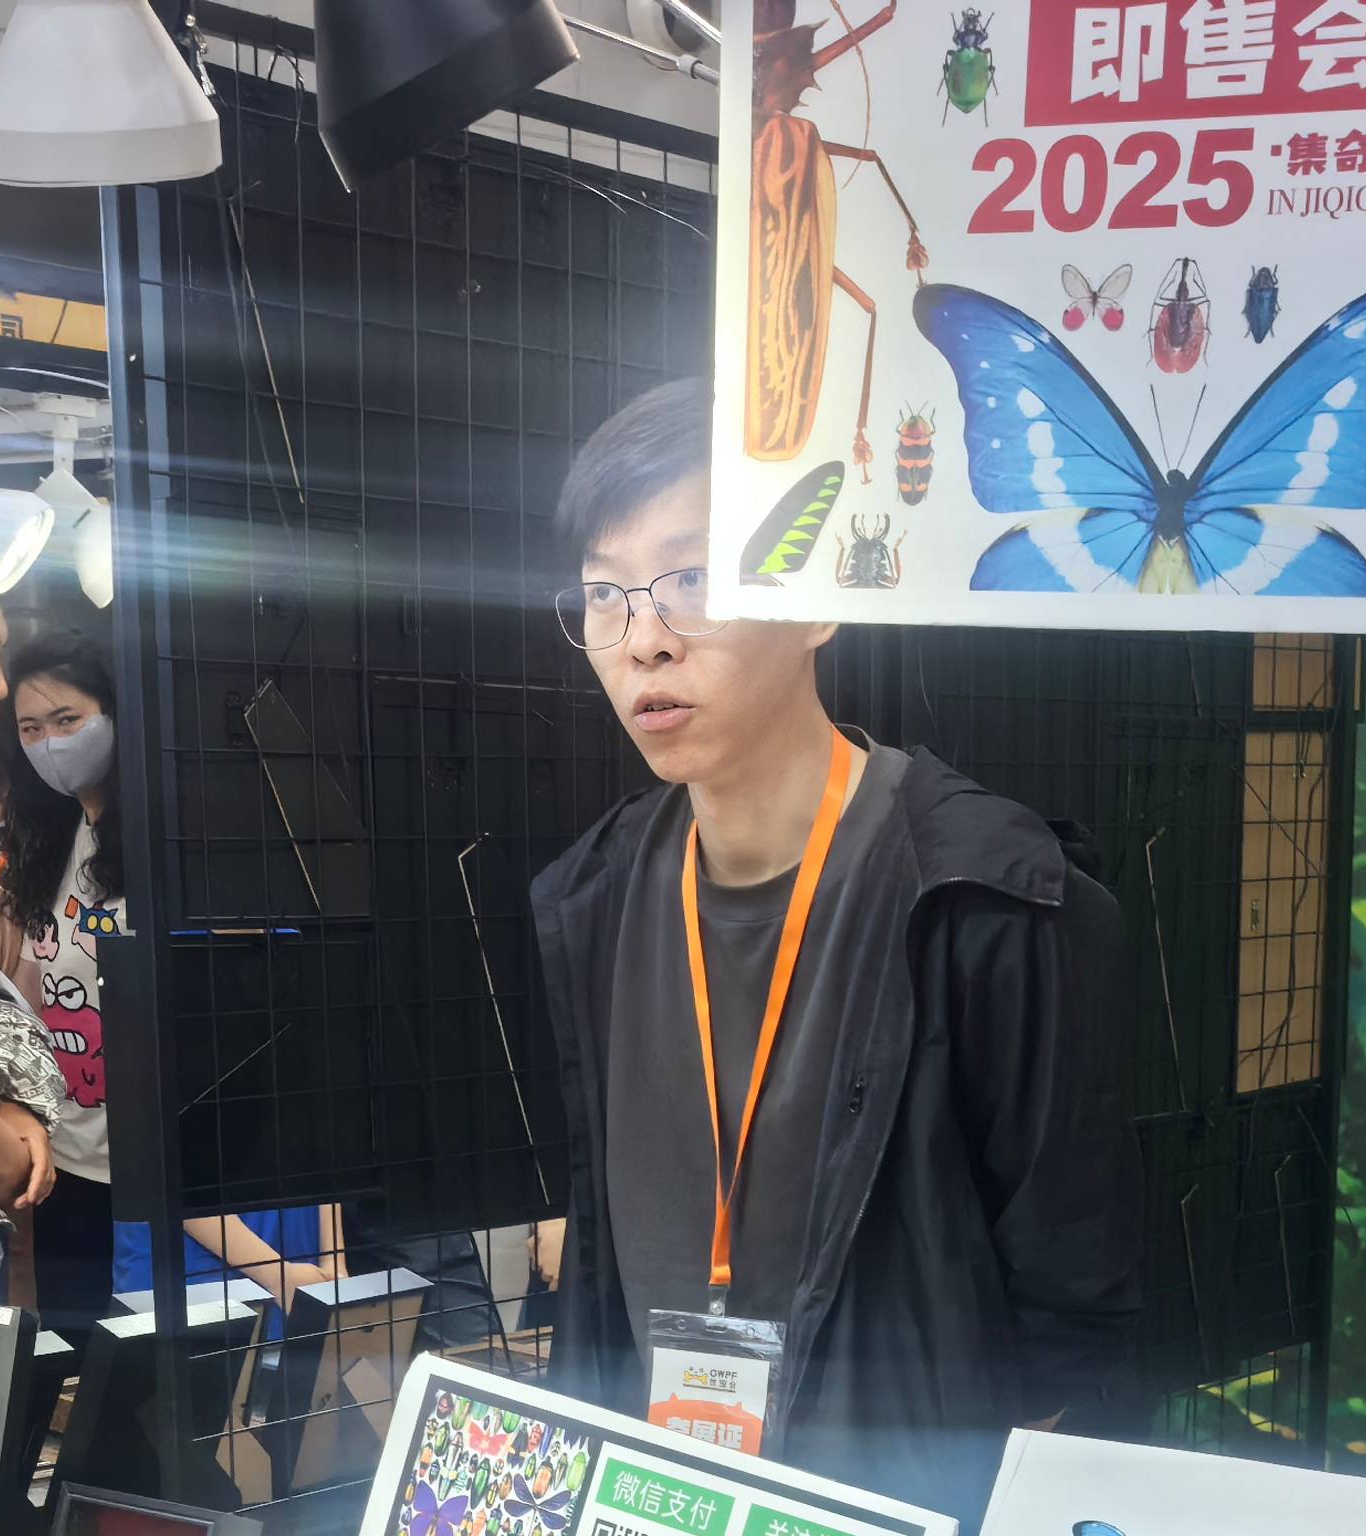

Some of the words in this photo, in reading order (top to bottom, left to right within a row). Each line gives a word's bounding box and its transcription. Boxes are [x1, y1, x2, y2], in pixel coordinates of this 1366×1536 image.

[967, 127, 1255, 235] 2025
[1266, 188, 1296, 217] IN
[612, 1468, 718, 1531] 微信支付
